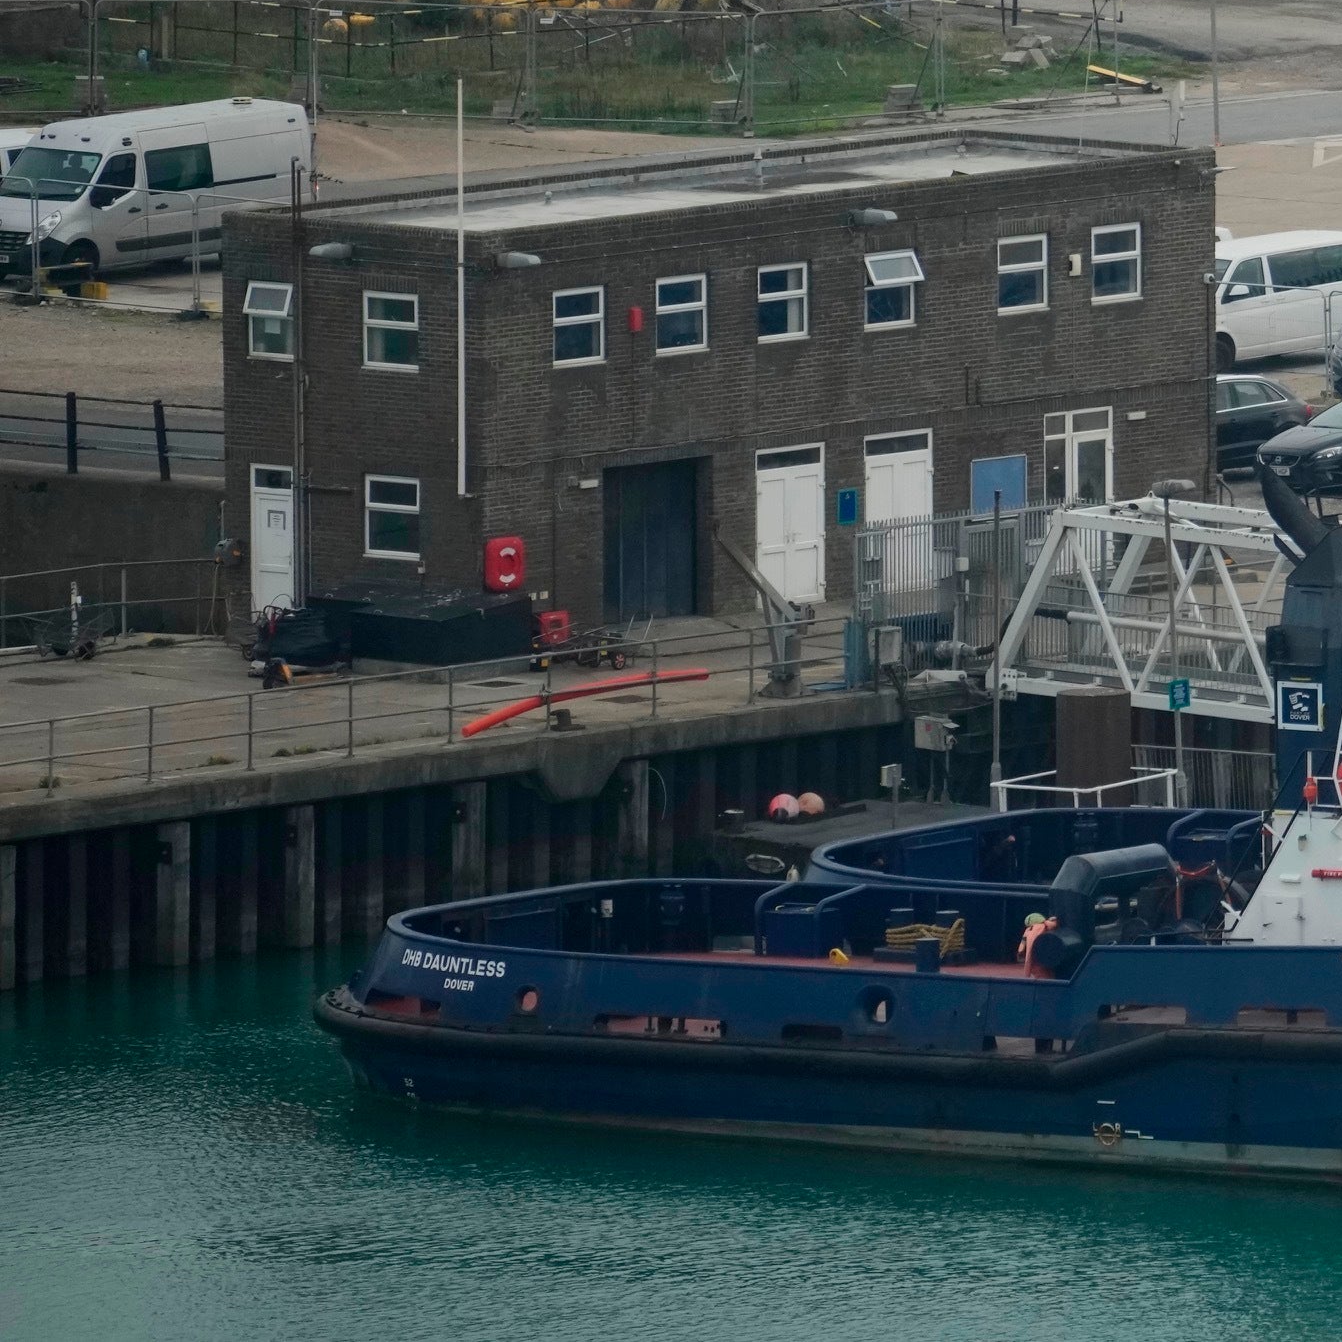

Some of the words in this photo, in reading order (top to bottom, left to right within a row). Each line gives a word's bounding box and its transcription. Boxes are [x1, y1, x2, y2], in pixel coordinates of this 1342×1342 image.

[402, 948, 422, 967] DHB
[422, 952, 506, 978] DAUNTLESS
[443, 978, 475, 992] DOVER
